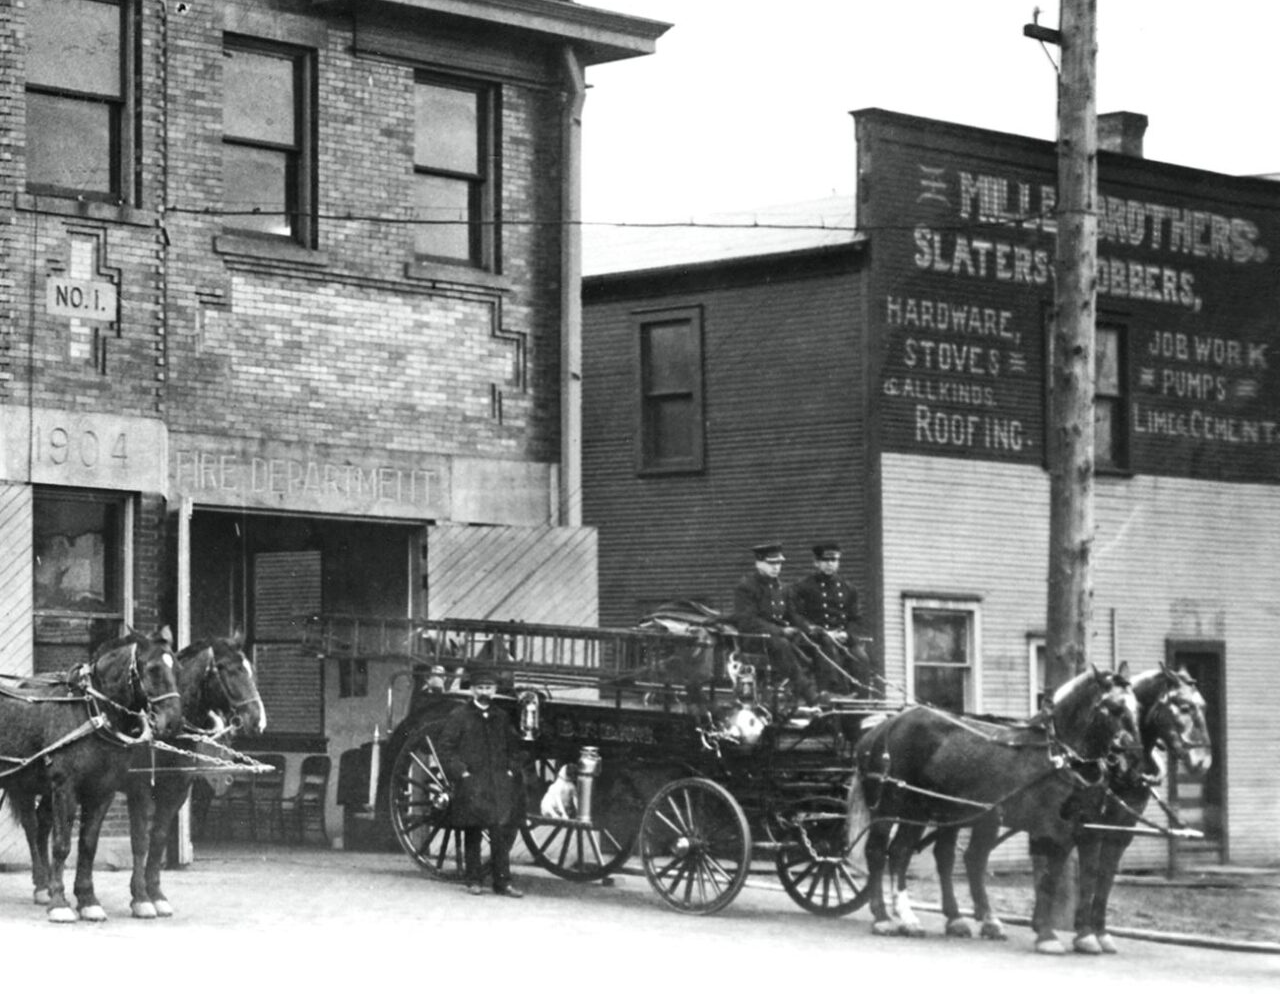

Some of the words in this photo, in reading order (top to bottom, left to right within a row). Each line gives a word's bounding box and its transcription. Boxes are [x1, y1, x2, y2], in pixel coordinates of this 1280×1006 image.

[959, 171, 1058, 233] MILLE
[913, 223, 1048, 285] SLATERS
[1097, 258, 1202, 312] OBBERS,
[886, 295, 1022, 344] HARDWARE,
[904, 337, 1001, 377] STOVES
[1148, 330, 1189, 361] JOB
[1193, 335, 1269, 369] WORK
[1162, 369, 1226, 401] PUMPS
[36, 426, 128, 472] 1904
[916, 405, 1033, 451] ROOFING.
[176, 450, 237, 492] FIRE
[251, 457, 436, 506] DEPARTMENT
